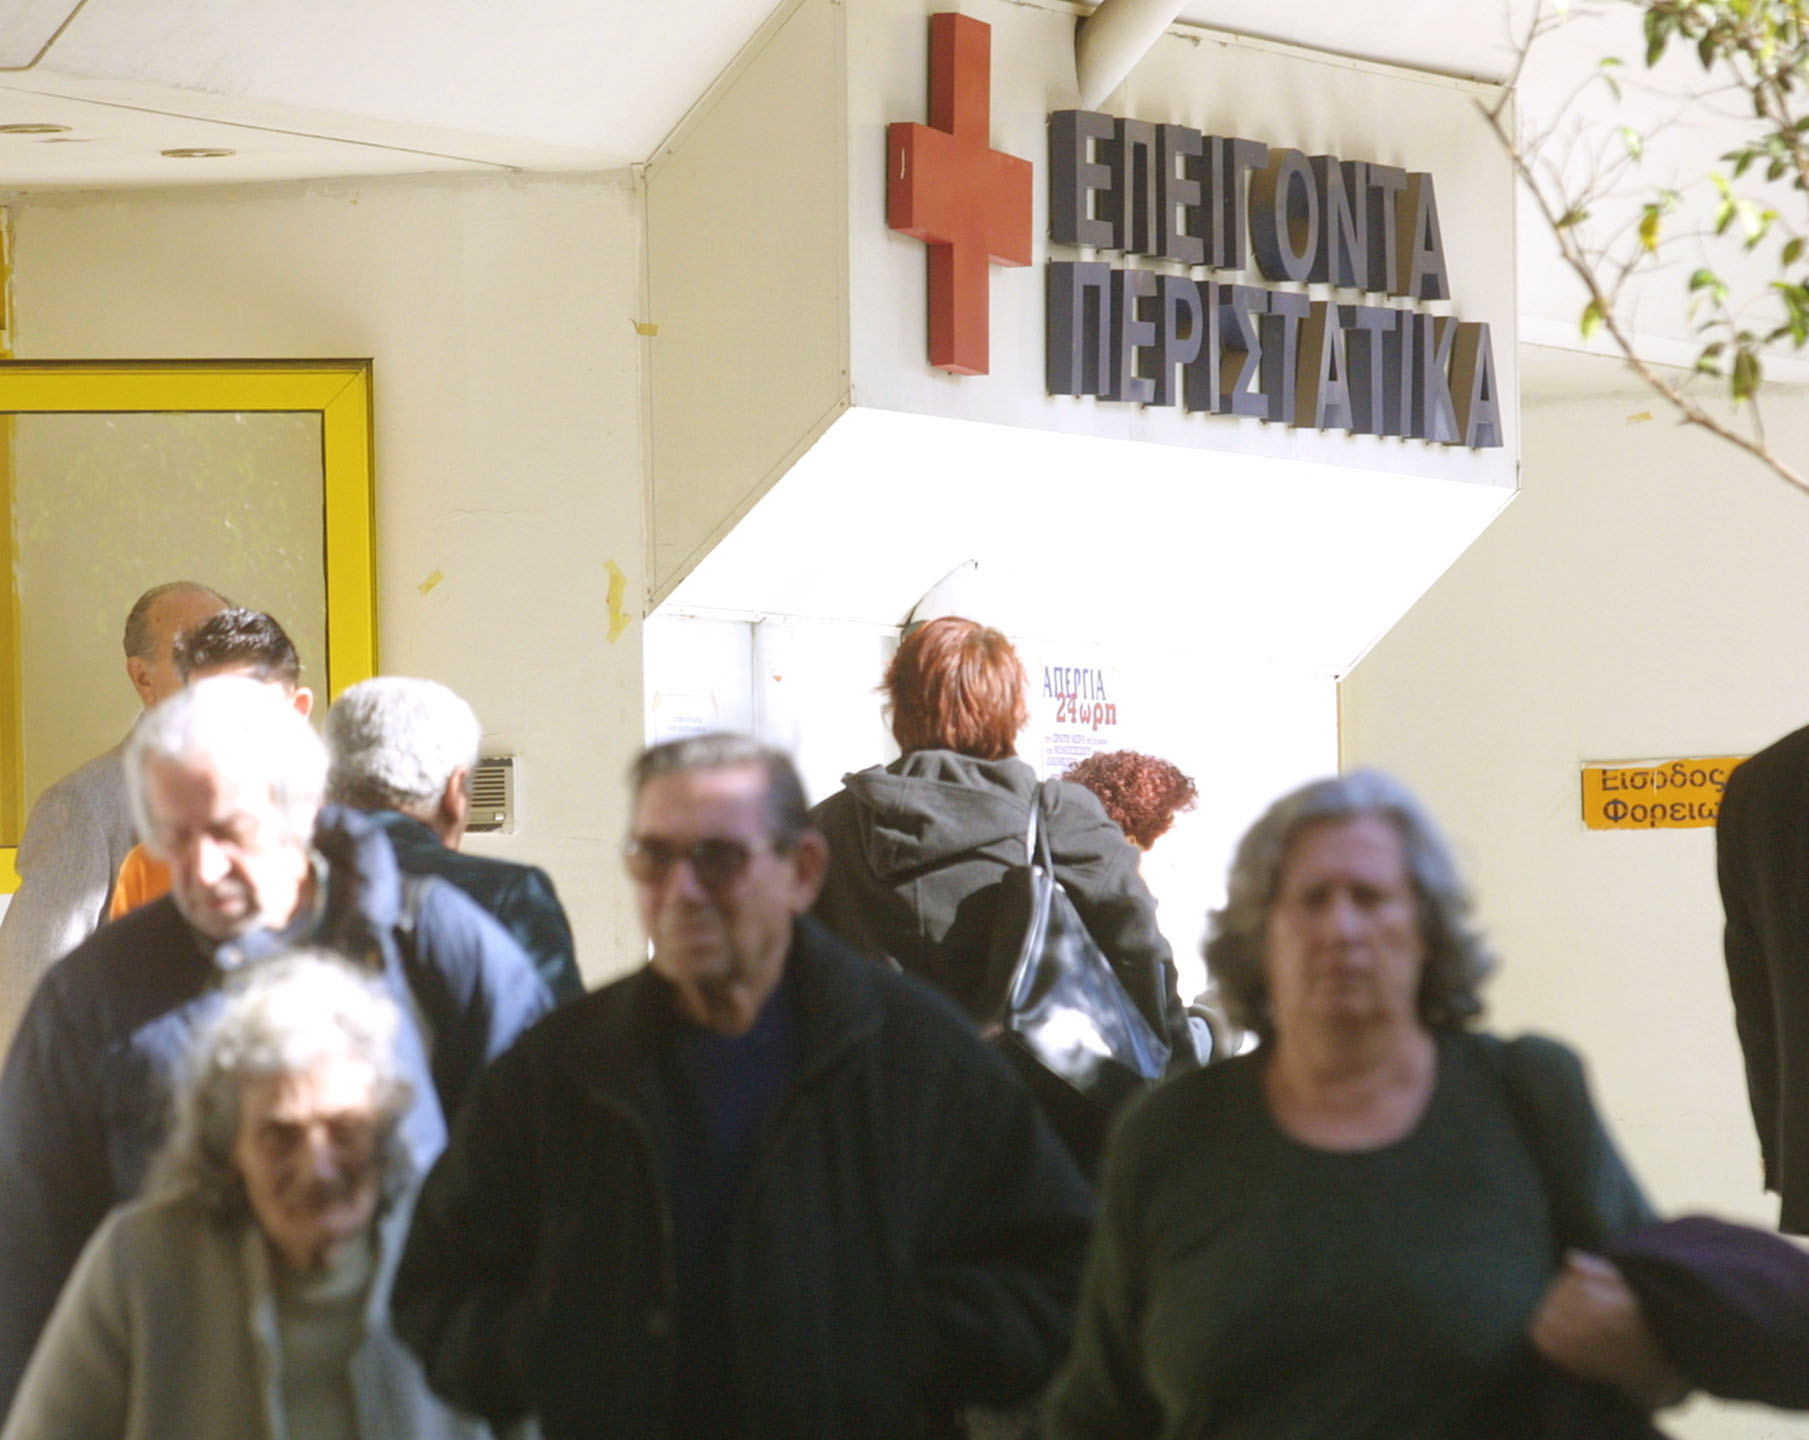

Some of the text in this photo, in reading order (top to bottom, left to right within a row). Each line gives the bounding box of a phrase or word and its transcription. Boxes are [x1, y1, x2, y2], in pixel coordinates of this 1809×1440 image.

[1049, 109, 1450, 300] ΕΠΕΙΓΟΝΤΑ
[1047, 261, 1503, 448] ΠΕΡΙΣΤΑΤΙΚΑ
[1043, 666, 1106, 700] ΑΠΕΡΓΙΑ
[1603, 798, 1719, 828] Φορειω
